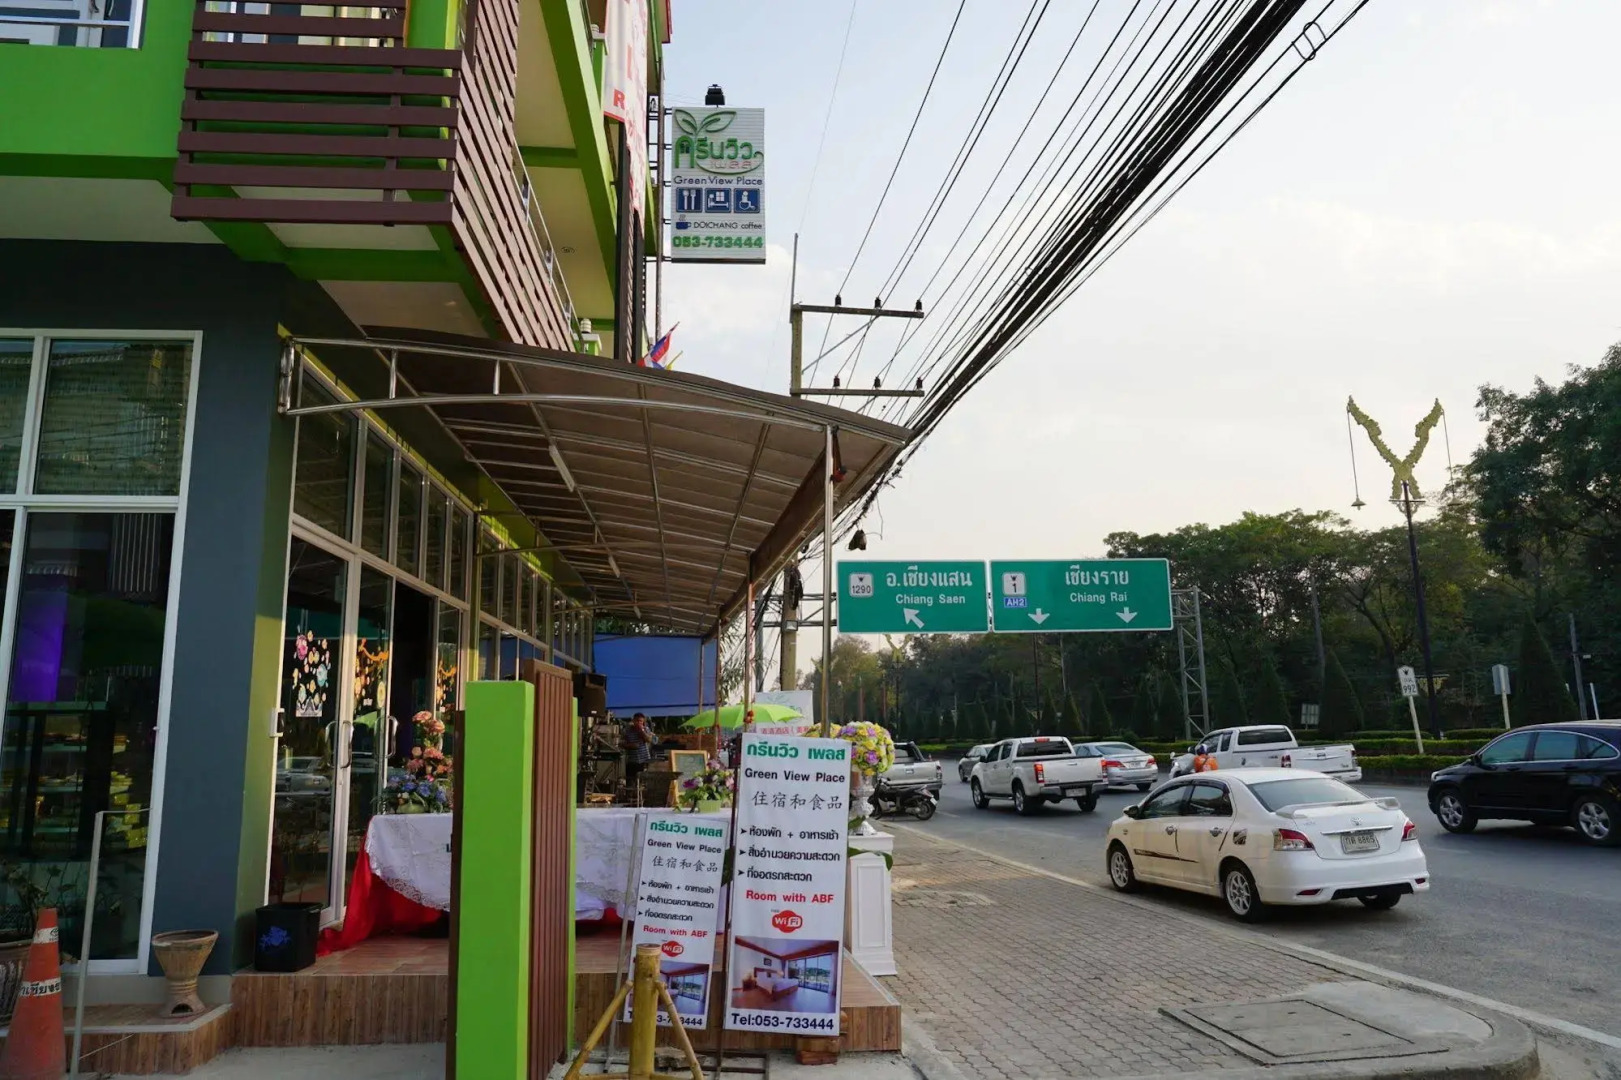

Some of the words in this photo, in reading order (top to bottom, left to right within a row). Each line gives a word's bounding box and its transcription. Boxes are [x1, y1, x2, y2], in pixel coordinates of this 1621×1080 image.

[673, 175, 707, 185] Green
[708, 176, 733, 185] View
[736, 177, 763, 186] Place
[740, 221, 762, 230] coffee
[672, 235, 763, 249] 053-733444
[886, 565, 973, 587] อ.เชียงแสน
[1065, 564, 1129, 586] เชียงราย
[852, 585, 872, 594] 1290
[1069, 592, 1106, 604] Chiang
[1110, 591, 1128, 602] Rai
[895, 594, 934, 607] Chiang
[938, 594, 966, 604] Saen
[747, 741, 799, 758] กรีนวิว
[808, 747, 845, 760] เพลส
[744, 767, 778, 780] Green
[783, 770, 810, 781] View
[815, 772, 845, 783] Place
[752, 790, 843, 811] 住宿和食品
[650, 820, 688, 834] กรีนวิว
[694, 826, 723, 838] เพลส
[749, 825, 782, 838] ห้องพัก
[799, 829, 839, 840] อาหารเช้า
[647, 838, 672, 848] Green
[676, 841, 696, 851] View
[699, 844, 722, 854] Place
[748, 844, 840, 862] สิ่งอำนวยความสะดวก
[652, 855, 718, 873] 住宿和食品
[746, 889, 777, 901] Room
[782, 892, 806, 903] with
[811, 894, 834, 903] ABF
[643, 924, 666, 935] Room
[670, 928, 687, 936] with
[691, 930, 708, 938] ABF
[731, 1012, 835, 1030] Tel:053-733444
